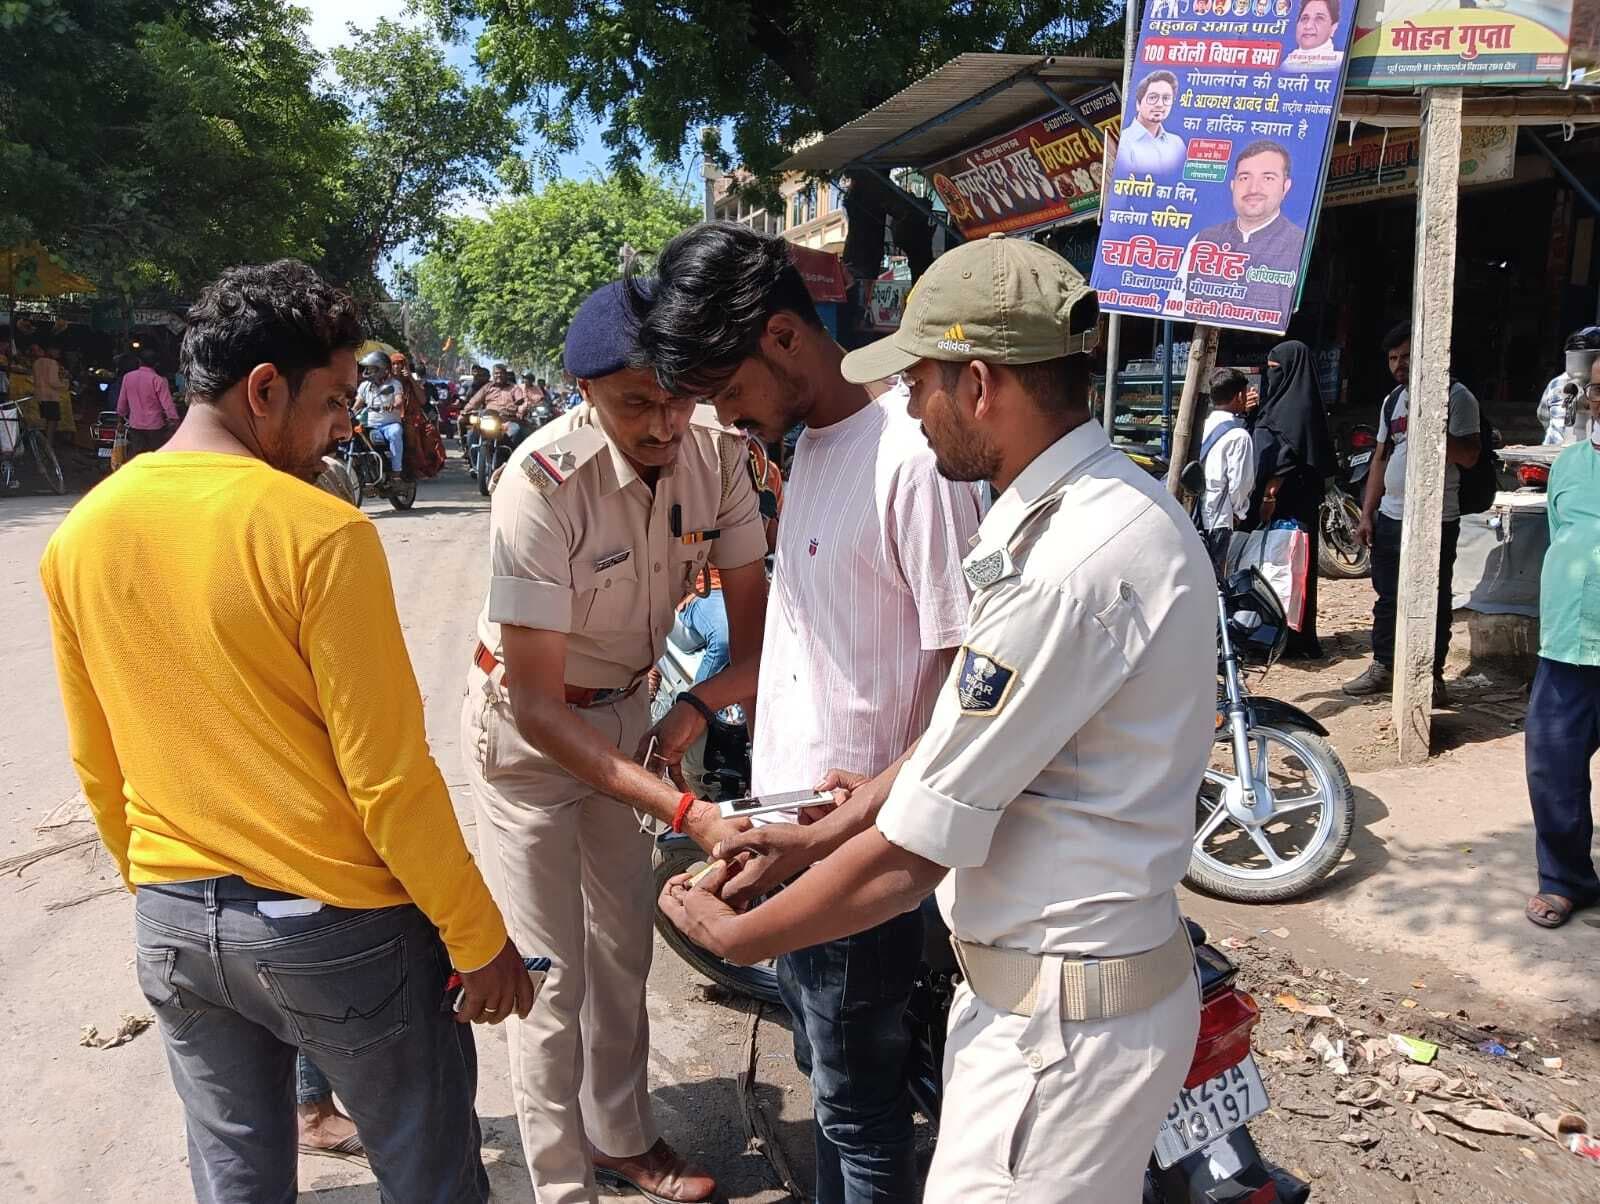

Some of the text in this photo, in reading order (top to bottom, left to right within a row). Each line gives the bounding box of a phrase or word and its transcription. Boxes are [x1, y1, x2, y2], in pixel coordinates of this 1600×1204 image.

[1251, 18, 1290, 35] पार्टी
[1391, 20, 1515, 60] मोहन गुप्ता
[1144, 44, 1165, 61] 100
[1209, 42, 1249, 64] विधान
[1251, 48, 1280, 66] सभा
[1187, 68, 1332, 93] गोपालगंज की धरती पर
[1179, 88, 1193, 108] श्री
[1194, 94, 1232, 110] आकाश
[1233, 91, 1264, 112] आनंद
[1183, 113, 1308, 140] का हार्दिक स्वागत है
[1156, 185, 1172, 199] का
[1109, 205, 1193, 230] बदलेगा सचिन
[1102, 235, 1184, 271] सचिन
[1187, 240, 1249, 280] सिंह
[1121, 271, 1152, 288] जिला
[1189, 278, 1247, 299] गोपालगंज
[1165, 298, 1184, 311] 100
[1220, 301, 1256, 321] विधान
[1256, 308, 1281, 325] सभा
[937, 339, 971, 352] adidas
[1172, 1083, 1249, 1150] Y3197
